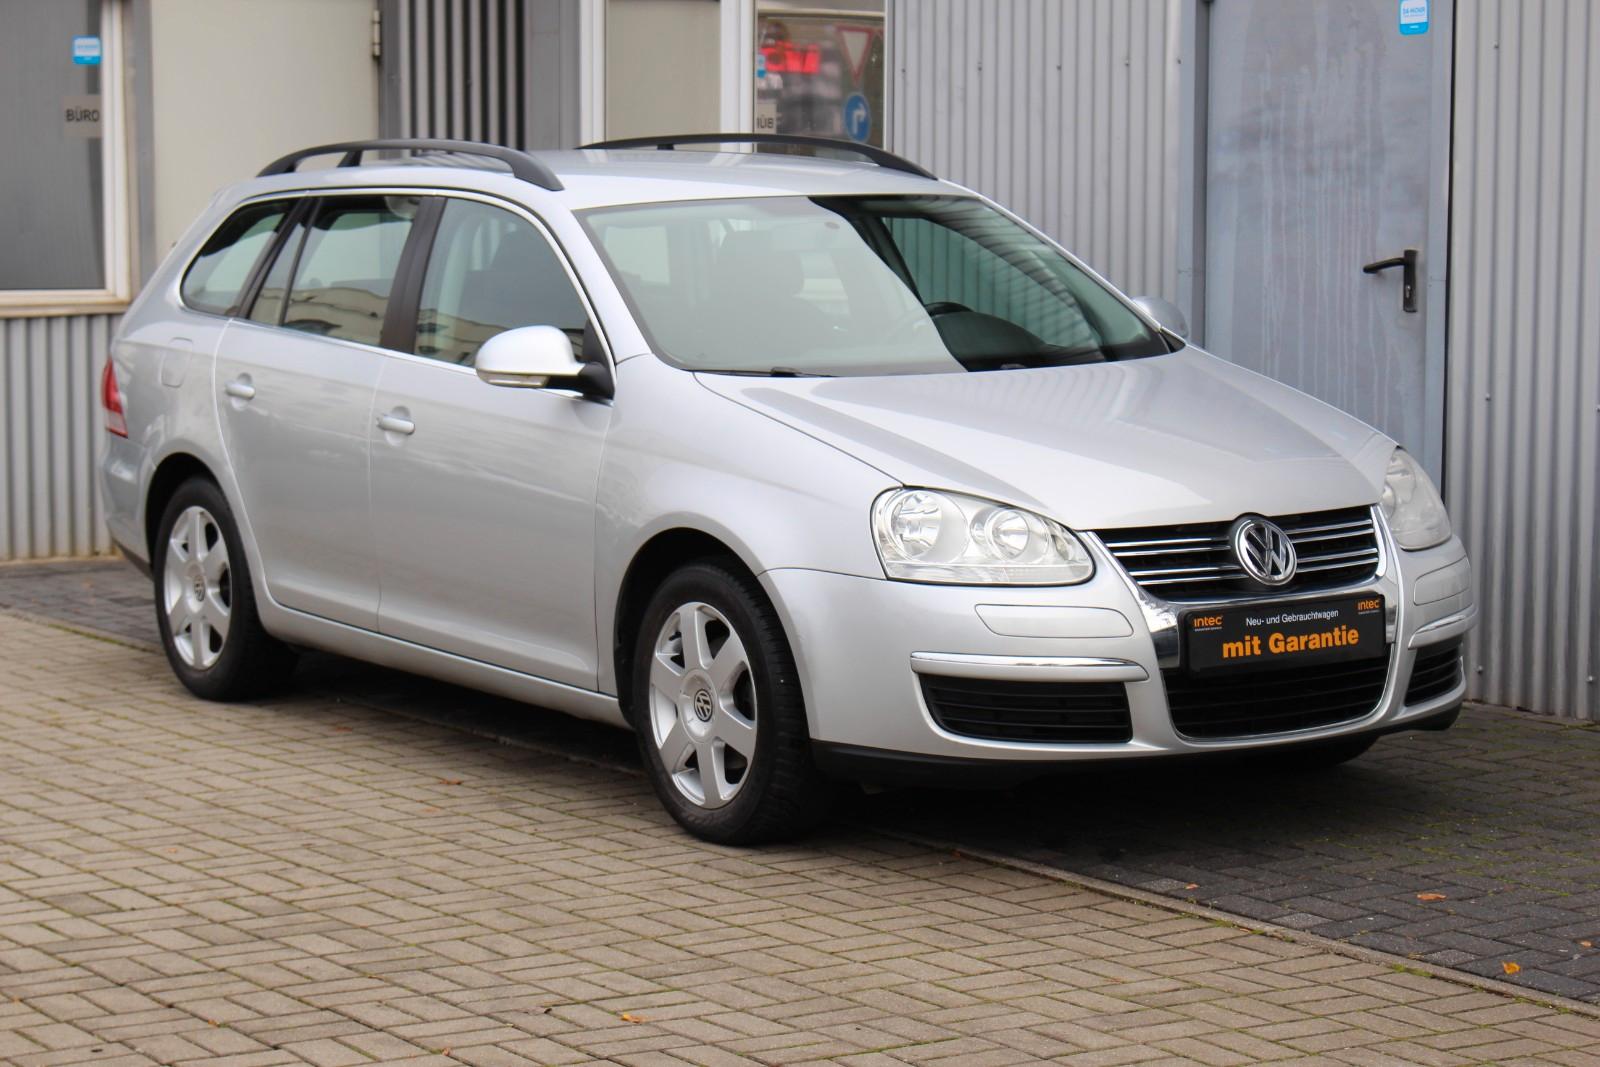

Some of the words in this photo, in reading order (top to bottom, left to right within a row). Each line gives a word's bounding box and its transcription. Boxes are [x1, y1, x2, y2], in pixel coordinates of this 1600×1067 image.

[66, 106, 100, 122] BÜRO
[1239, 521, 1295, 583] VW
[1357, 600, 1380, 611] intec
[1194, 615, 1223, 627] intec
[1246, 617, 1265, 626] Neu-
[1266, 616, 1280, 625] und
[1282, 610, 1339, 623] Gebrauchtwagen
[1222, 635, 1262, 658] mit
[1269, 625, 1360, 654] Garantie
